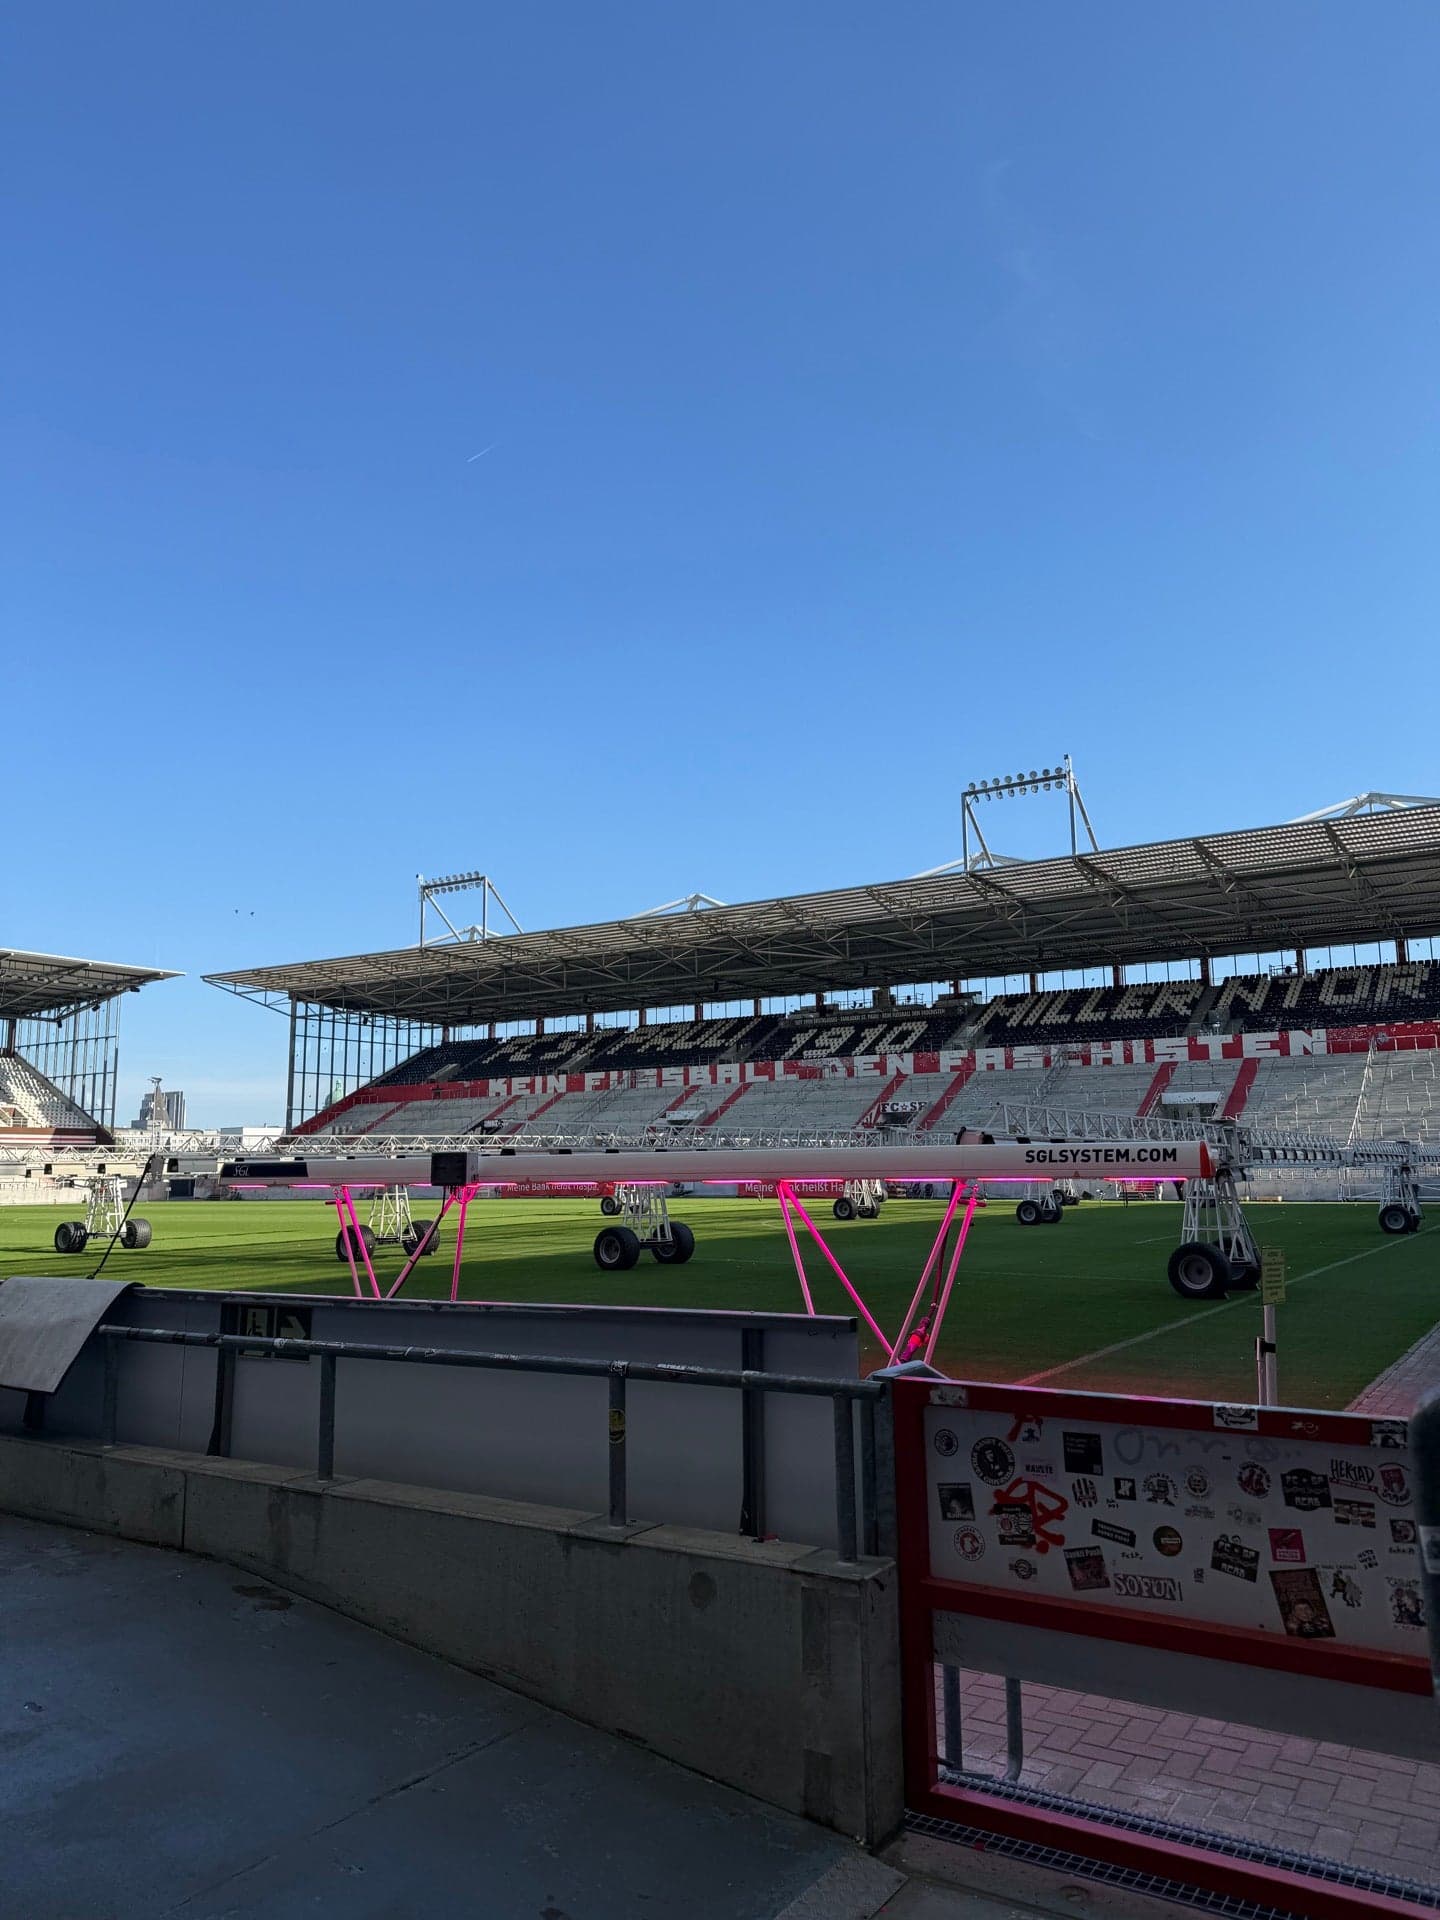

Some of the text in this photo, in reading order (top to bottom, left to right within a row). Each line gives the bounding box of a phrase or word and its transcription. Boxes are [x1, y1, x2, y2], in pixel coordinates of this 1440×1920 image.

[606, 1017, 761, 1055] PAULI
[781, 1021, 928, 1060] 1910
[489, 1074, 567, 1097] KEIN
[585, 1060, 800, 1091] FUSSBALL
[940, 1029, 1327, 1073] FASCHISTEN
[1025, 1147, 1178, 1163] SGLSYSTEM.COM
[745, 1182, 774, 1192] Meine
